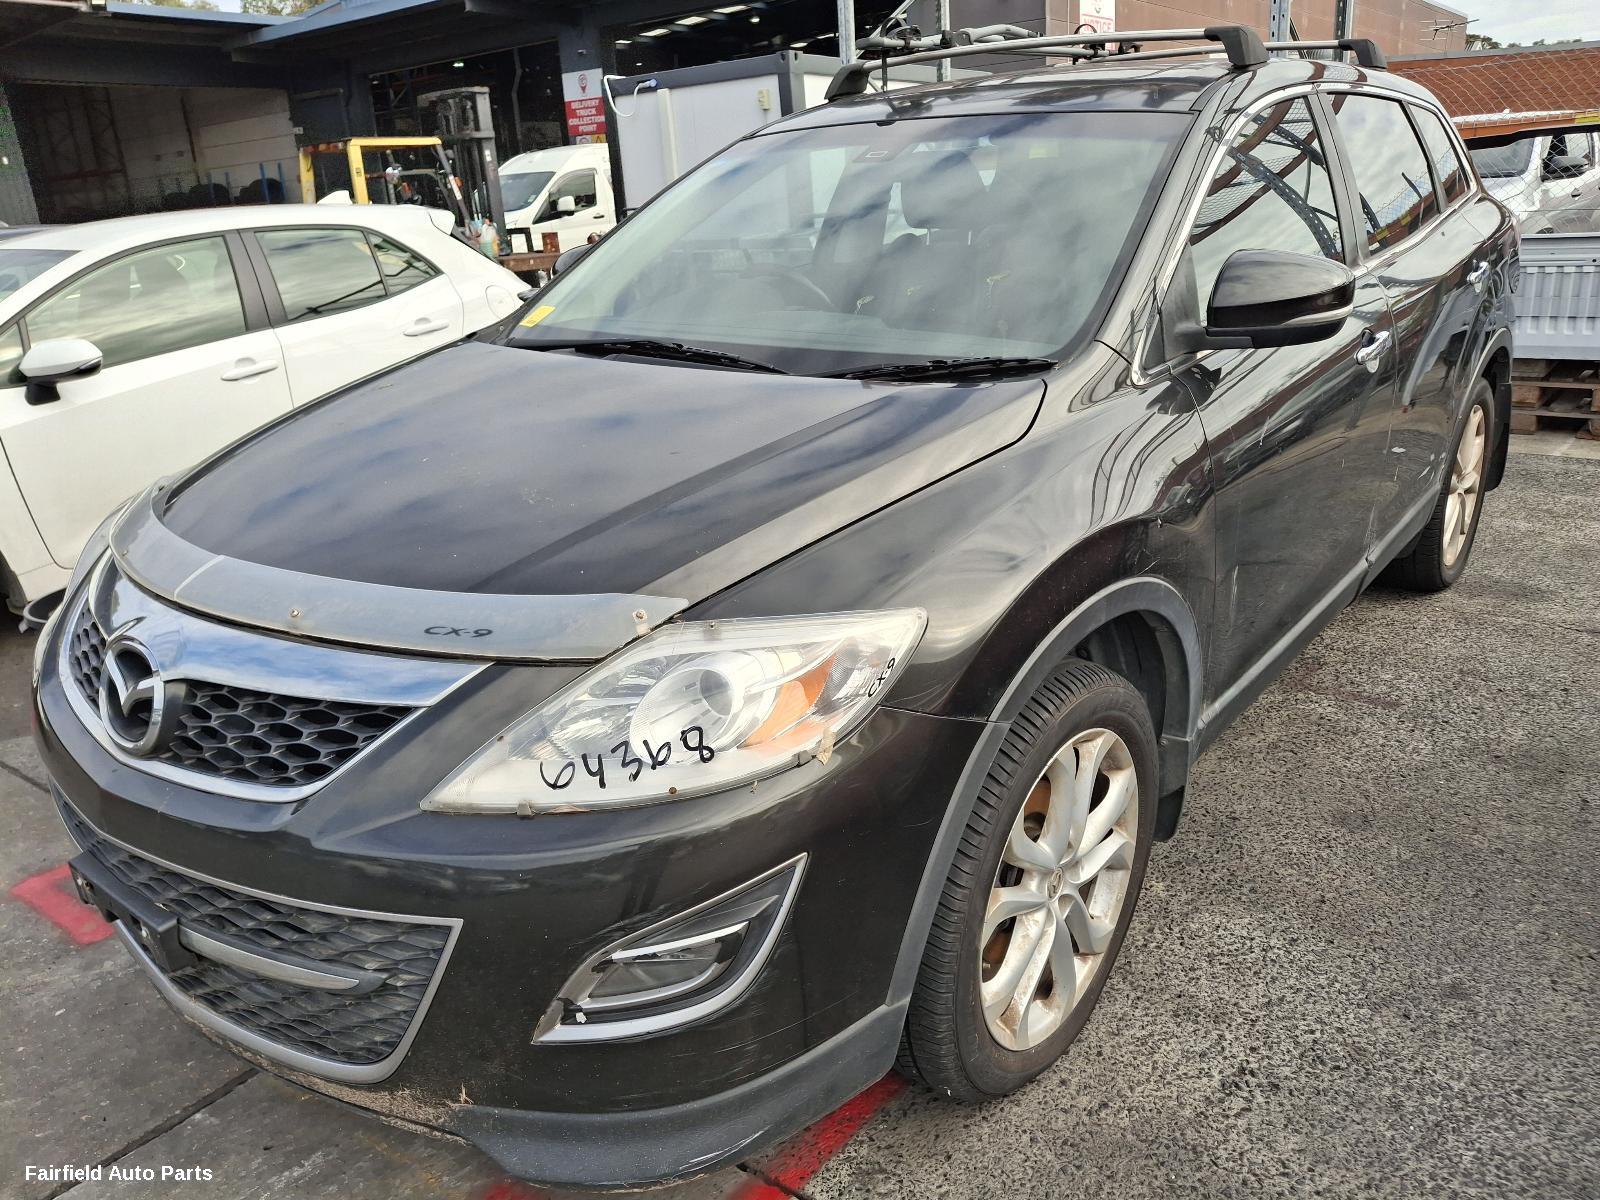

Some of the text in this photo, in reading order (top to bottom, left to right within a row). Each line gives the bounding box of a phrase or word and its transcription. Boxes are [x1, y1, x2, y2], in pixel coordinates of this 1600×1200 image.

[571, 99, 599, 109] DELIVERY
[576, 108, 597, 116] TRUCK
[568, 115, 606, 125] COLLECTION
[578, 124, 598, 132] POINT
[423, 625, 493, 638] CX-9
